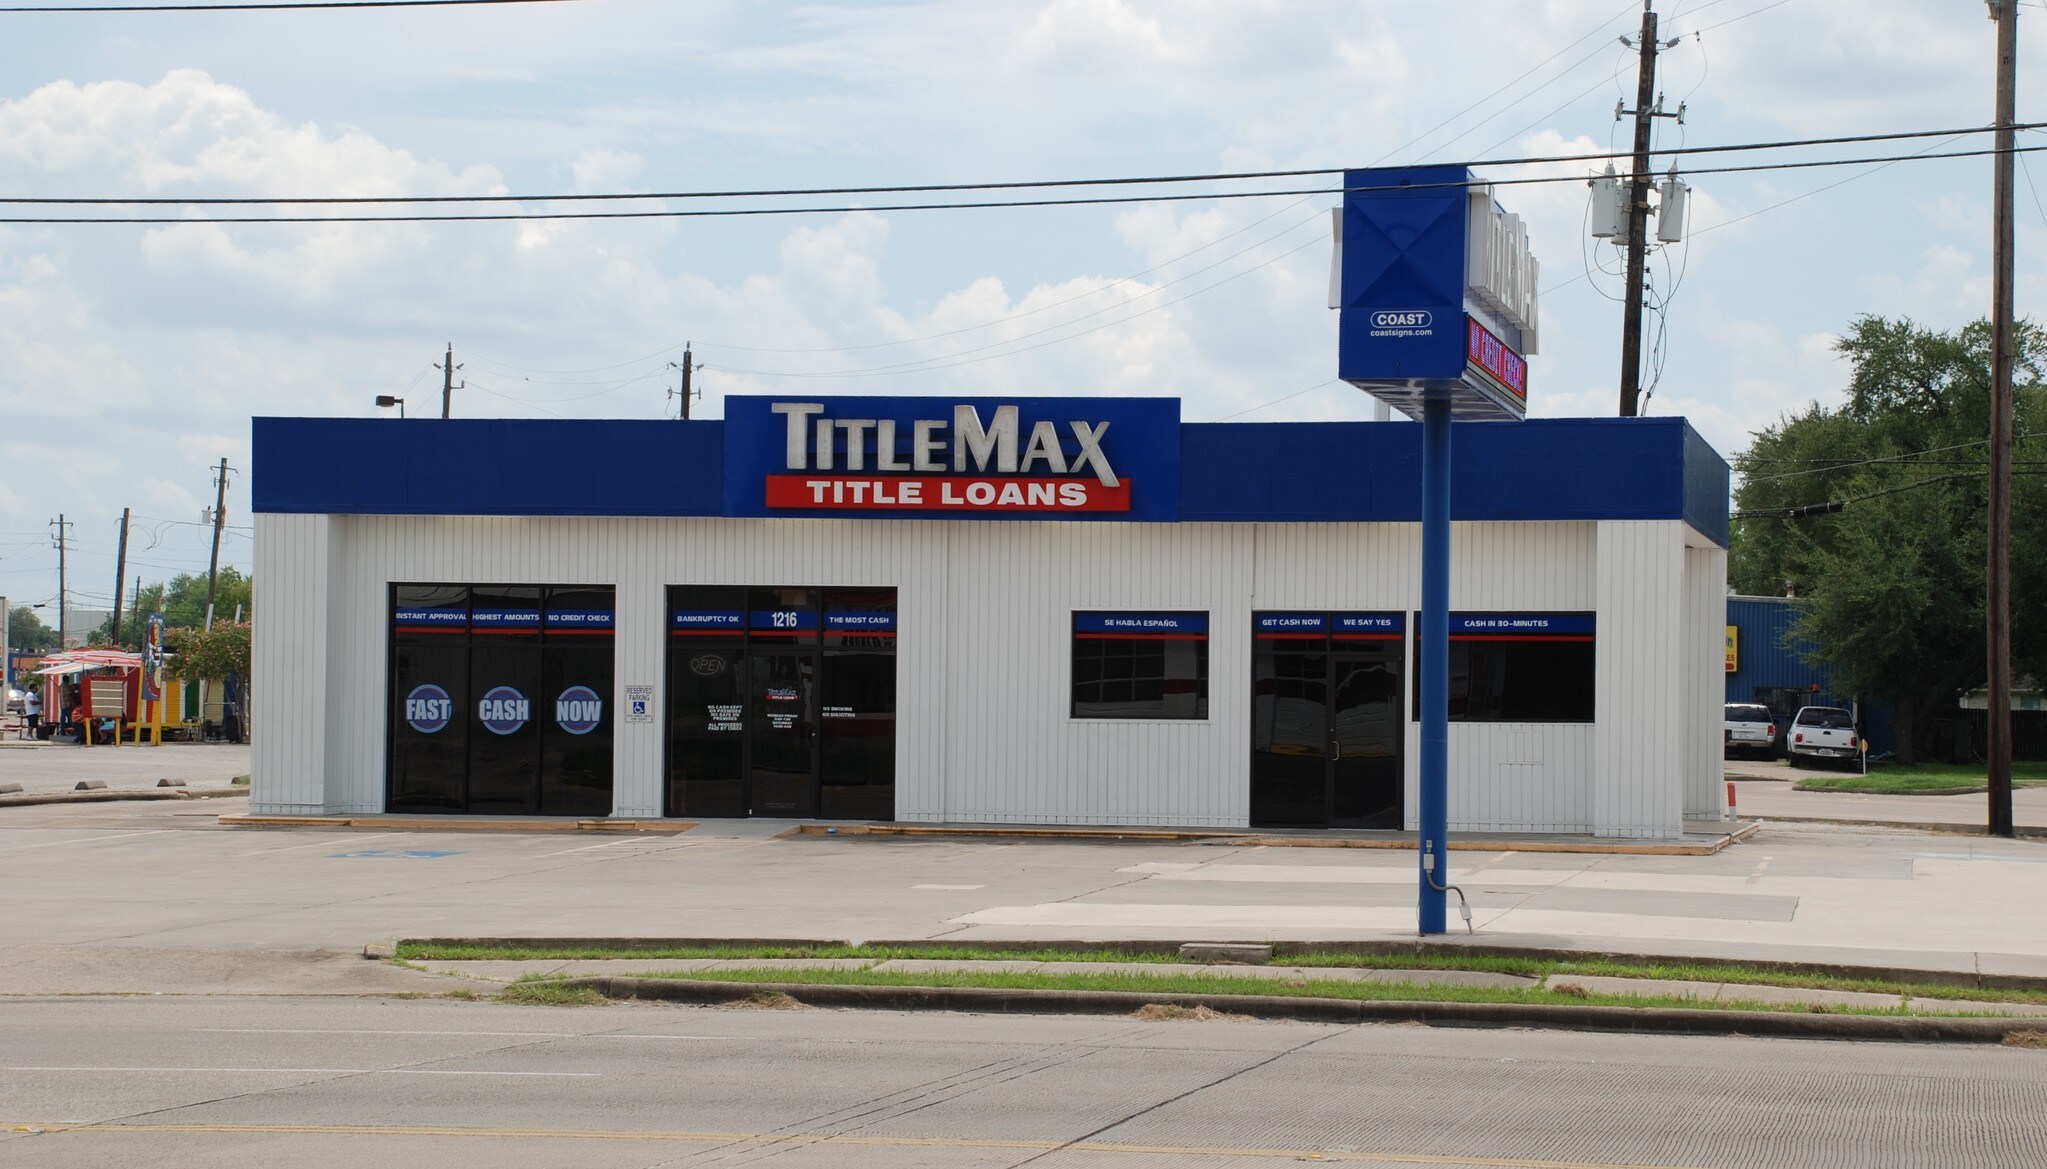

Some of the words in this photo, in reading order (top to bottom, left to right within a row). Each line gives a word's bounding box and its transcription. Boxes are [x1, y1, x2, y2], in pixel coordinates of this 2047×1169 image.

[1377, 313, 1425, 325] COAST
[1370, 329, 1432, 338] coastsigns.com
[806, 480, 923, 504] TITLE
[941, 481, 1088, 507] LOANS
[396, 612, 427, 620] INSTANT
[472, 613, 502, 621] HIGHEST
[504, 613, 540, 621] AMOUNTS
[561, 614, 586, 622] CREDIT
[587, 614, 610, 622] CHECK
[771, 611, 797, 627] 1216
[1143, 619, 1178, 627] ESPAÑOL
[691, 658, 726, 671] OPEN
[406, 699, 450, 721] FAST
[479, 699, 529, 721] CASH
[556, 700, 602, 722] NOW
